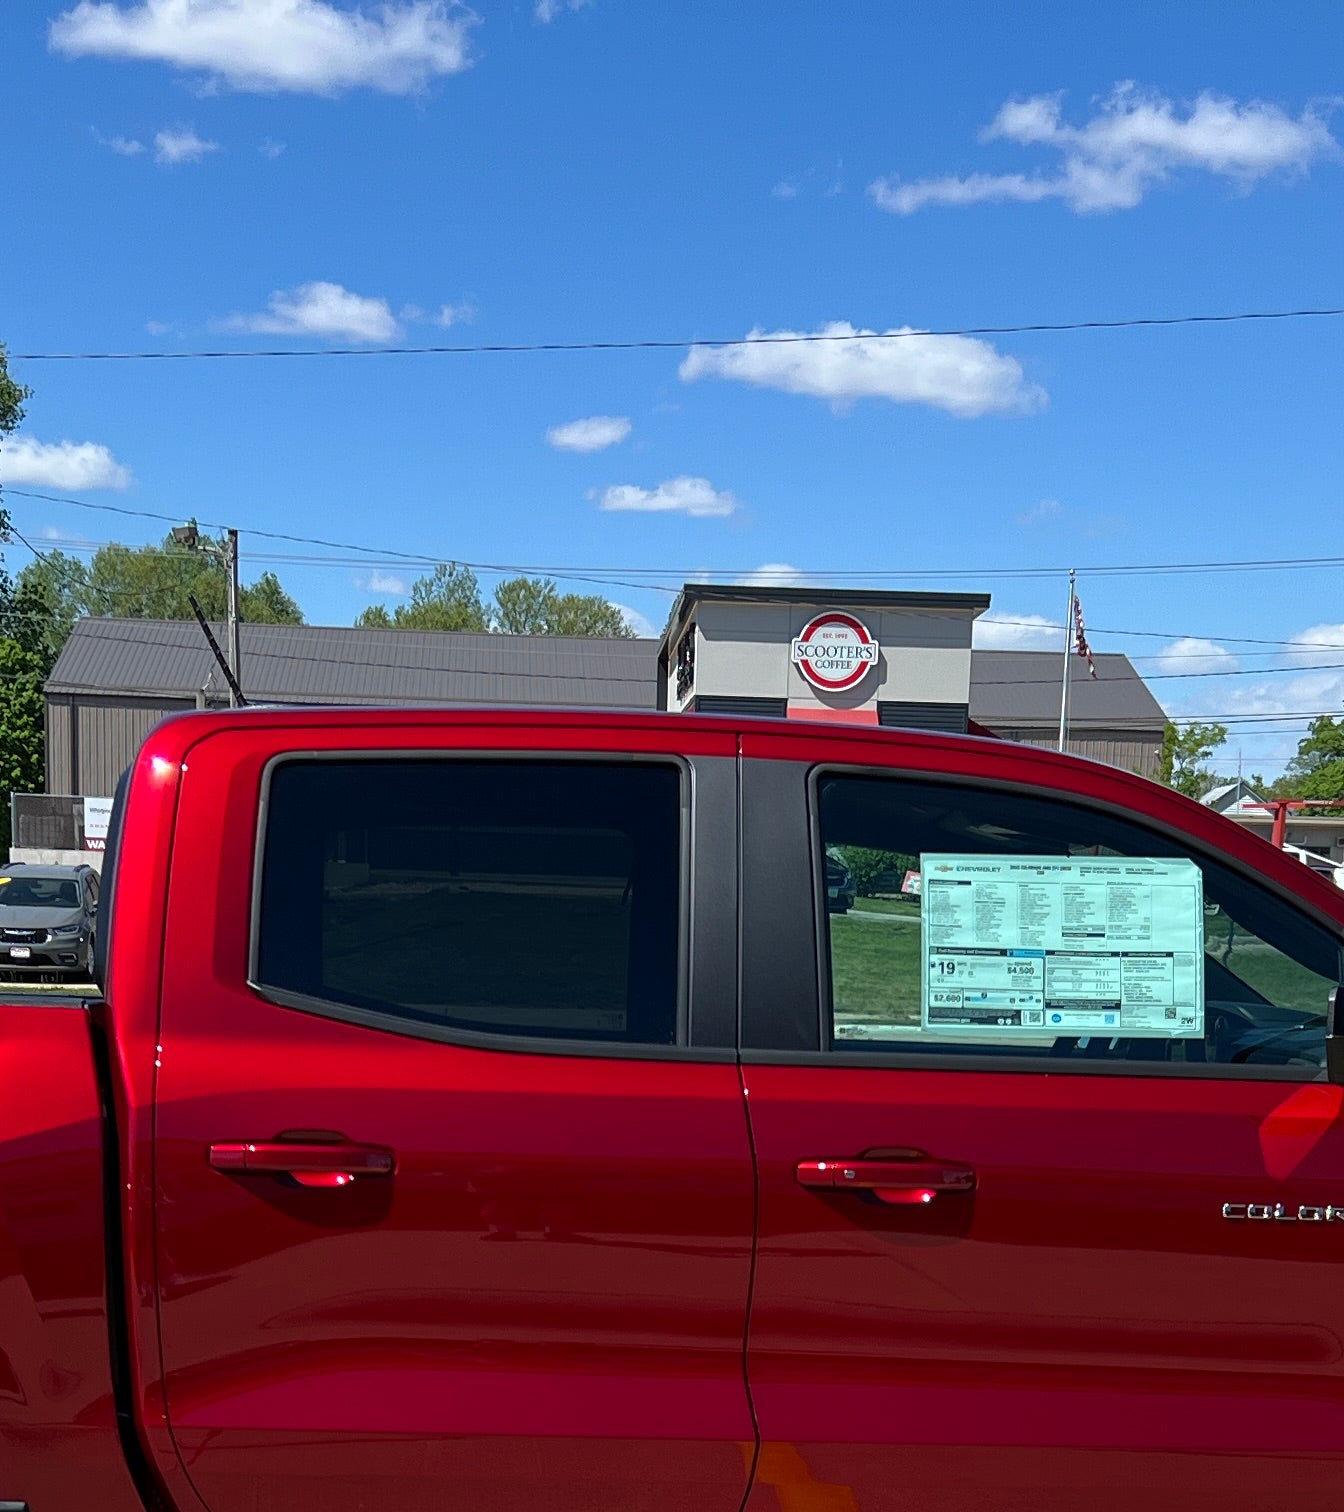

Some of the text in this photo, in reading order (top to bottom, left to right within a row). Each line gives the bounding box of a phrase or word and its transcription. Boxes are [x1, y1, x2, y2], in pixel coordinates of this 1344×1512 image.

[797, 645, 873, 659] SCOOTER'S
[815, 660, 852, 669] COFFEE
[938, 961, 956, 975] 19
